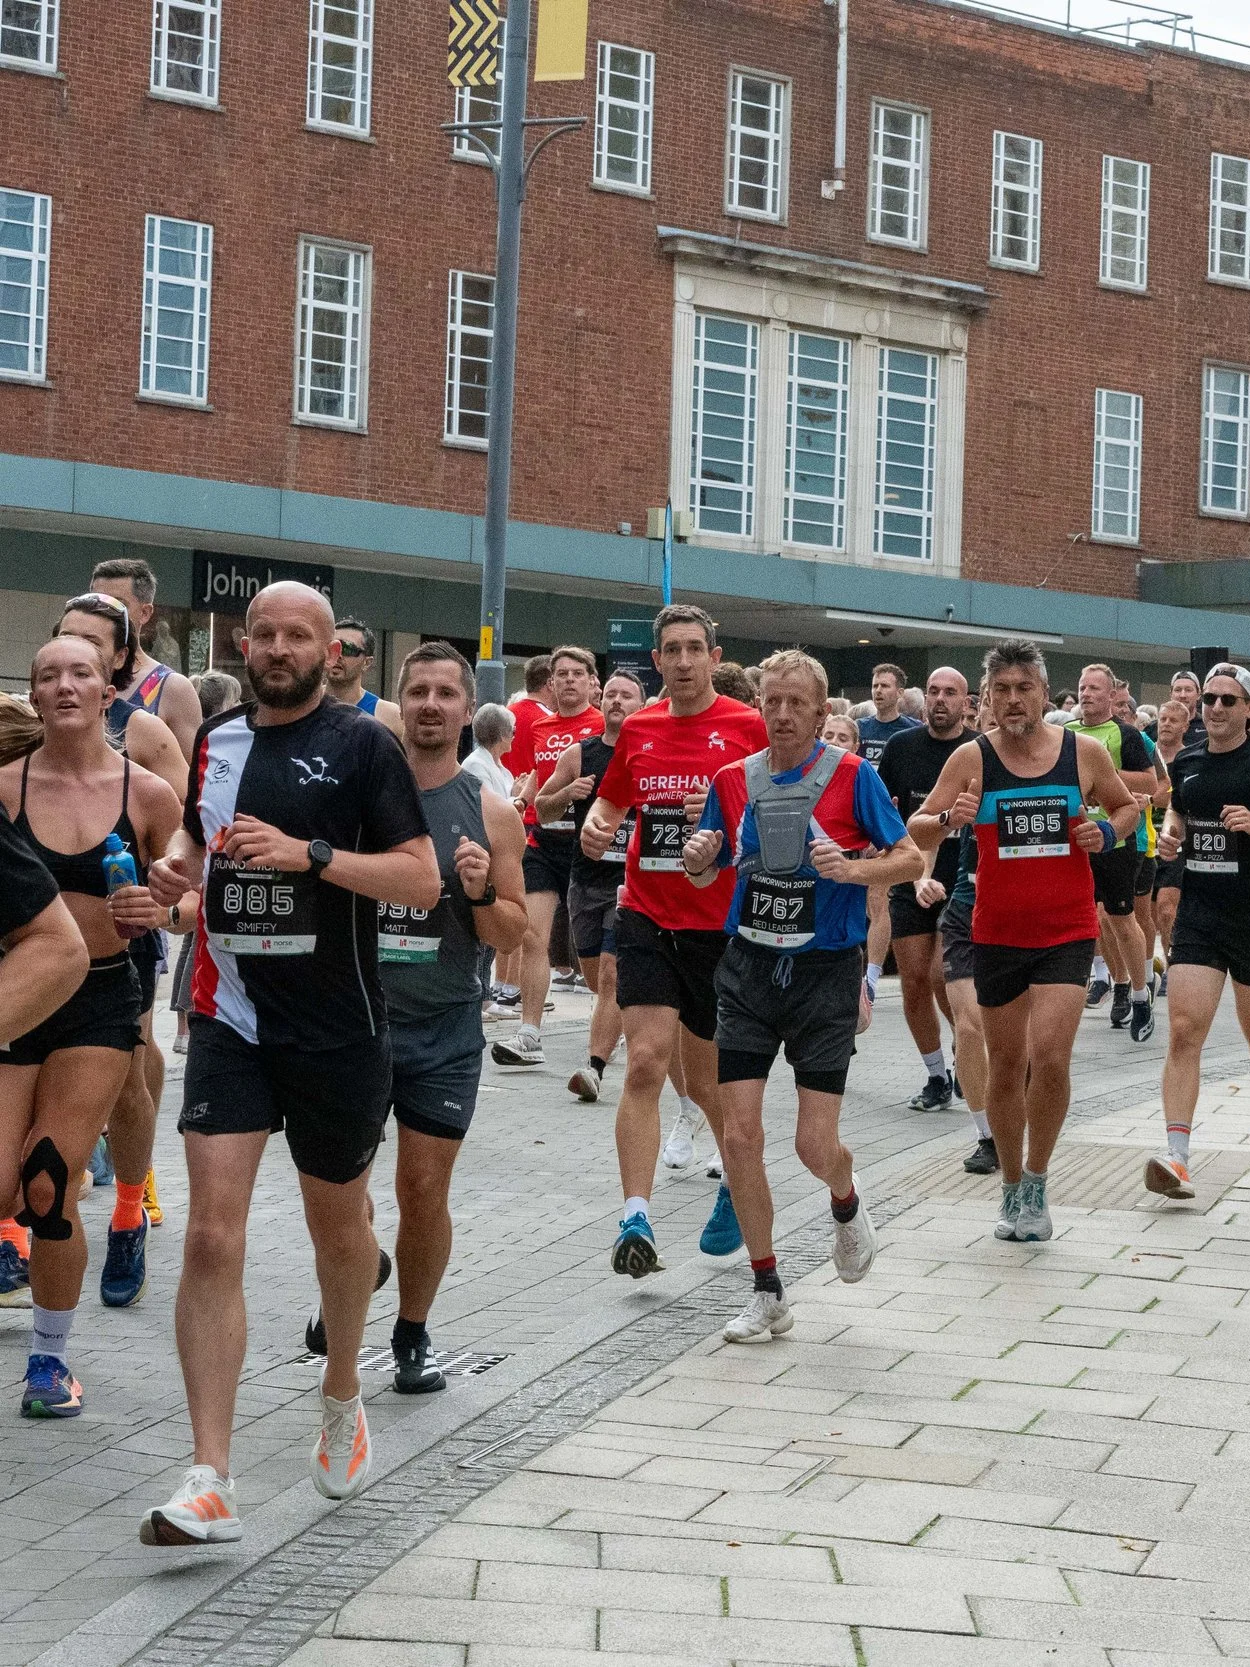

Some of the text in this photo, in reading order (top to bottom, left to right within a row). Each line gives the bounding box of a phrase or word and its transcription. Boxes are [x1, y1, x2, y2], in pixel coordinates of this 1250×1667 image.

[203, 561, 260, 603] John
[1004, 813, 1061, 835] 1365
[652, 824, 695, 845] 723
[1027, 837, 1042, 845] JOE
[223, 883, 294, 915] 885
[751, 891, 804, 920] 1767
[236, 921, 278, 933] SMIFFY
[384, 923, 408, 933] MATT
[752, 919, 798, 933] RED LEADER
[273, 939, 293, 947] norse
[444, 1100, 462, 1111] RITUAL
